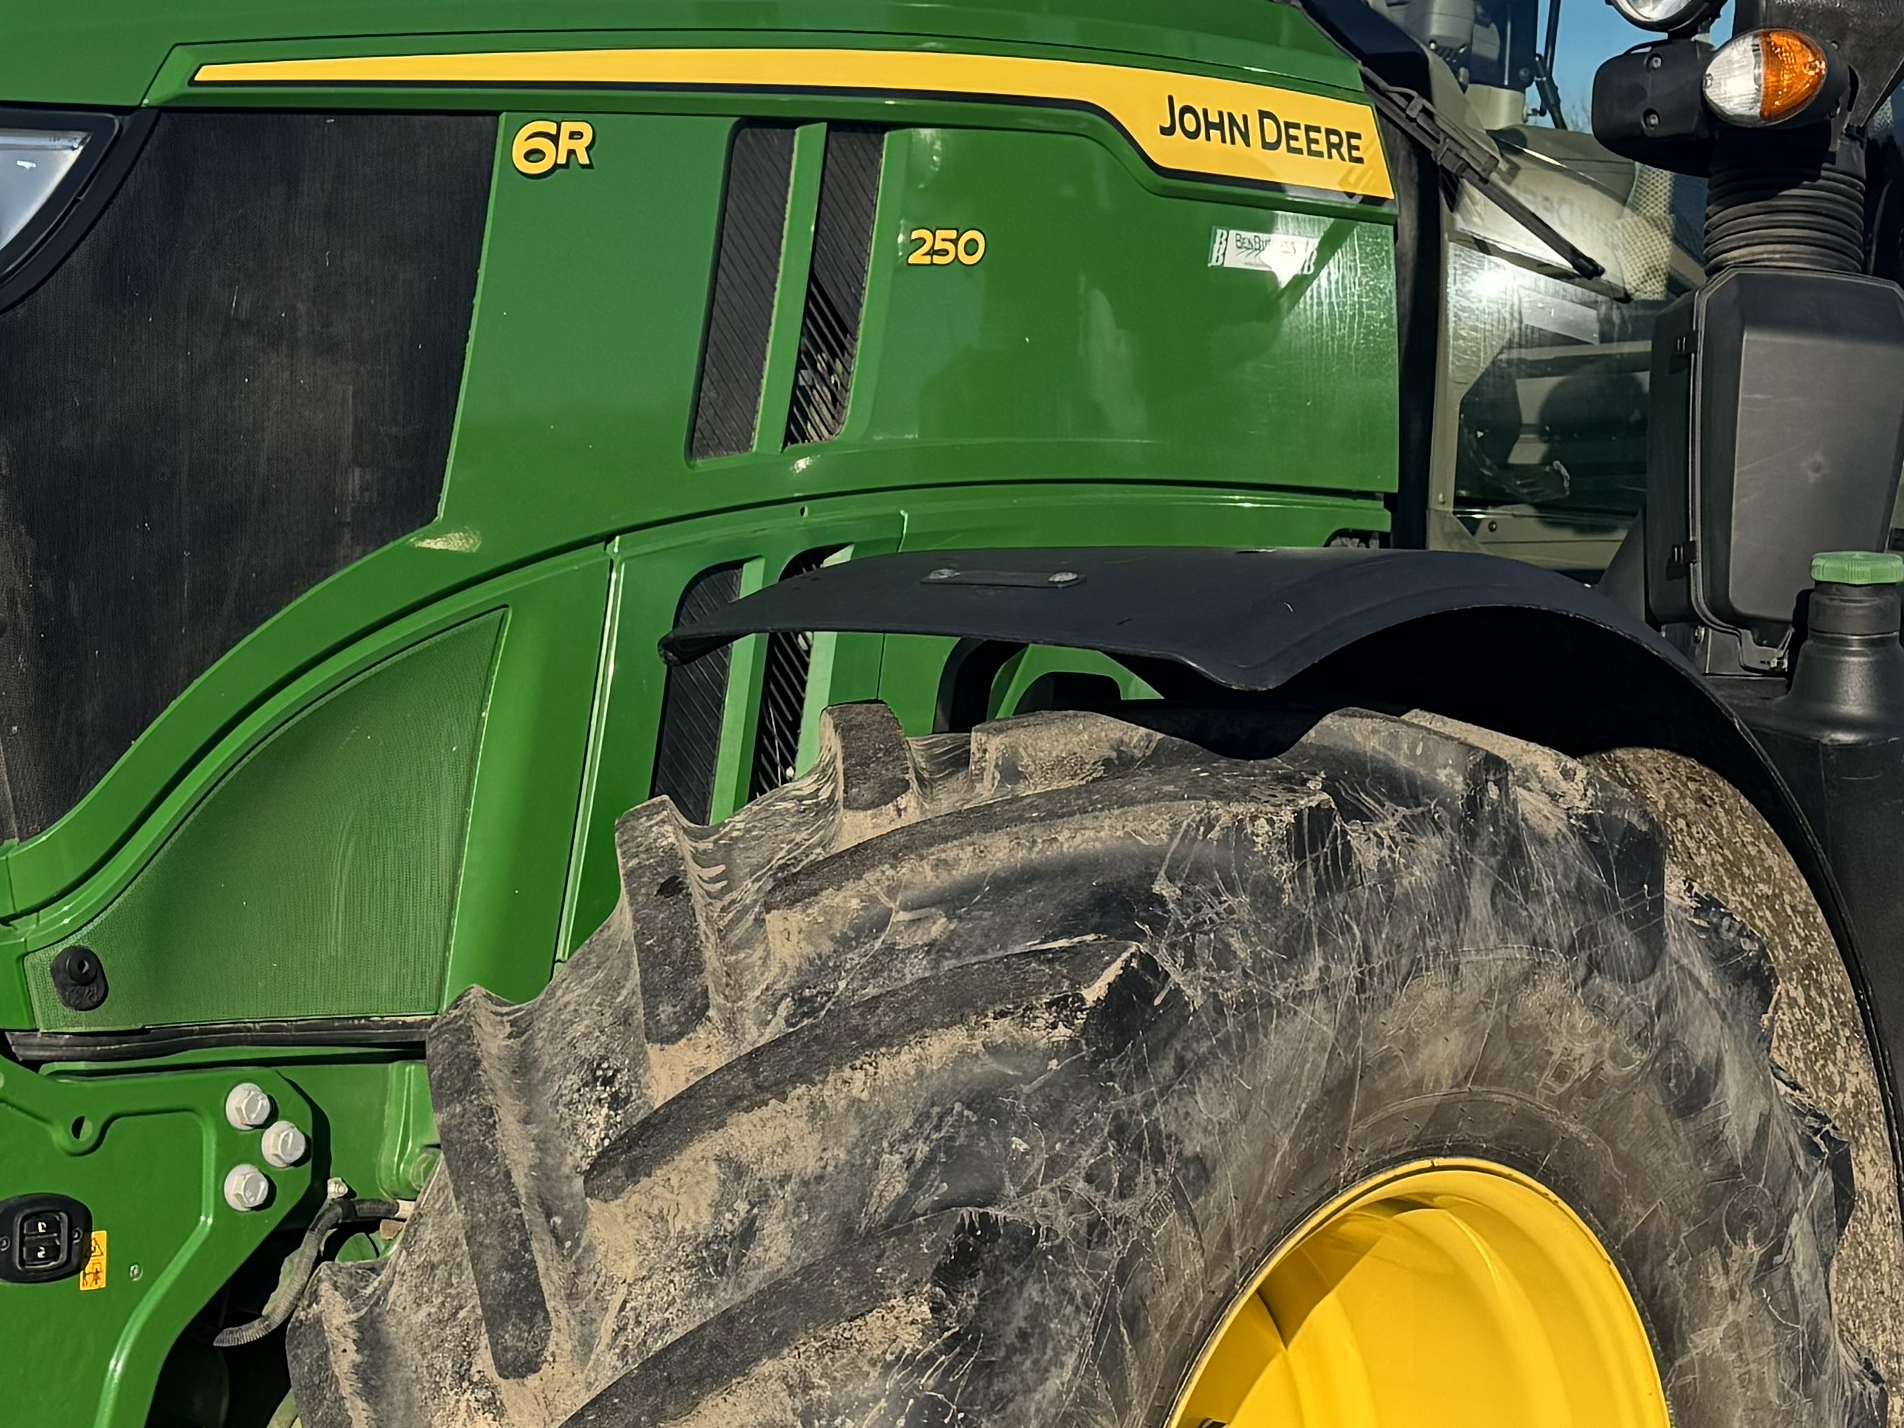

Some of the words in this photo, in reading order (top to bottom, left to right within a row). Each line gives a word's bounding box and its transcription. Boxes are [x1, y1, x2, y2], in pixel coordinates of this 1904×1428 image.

[511, 119, 595, 178] 6R
[1158, 94, 1251, 148] JOHN
[1257, 108, 1365, 164] DEERE
[907, 227, 987, 266] 250
